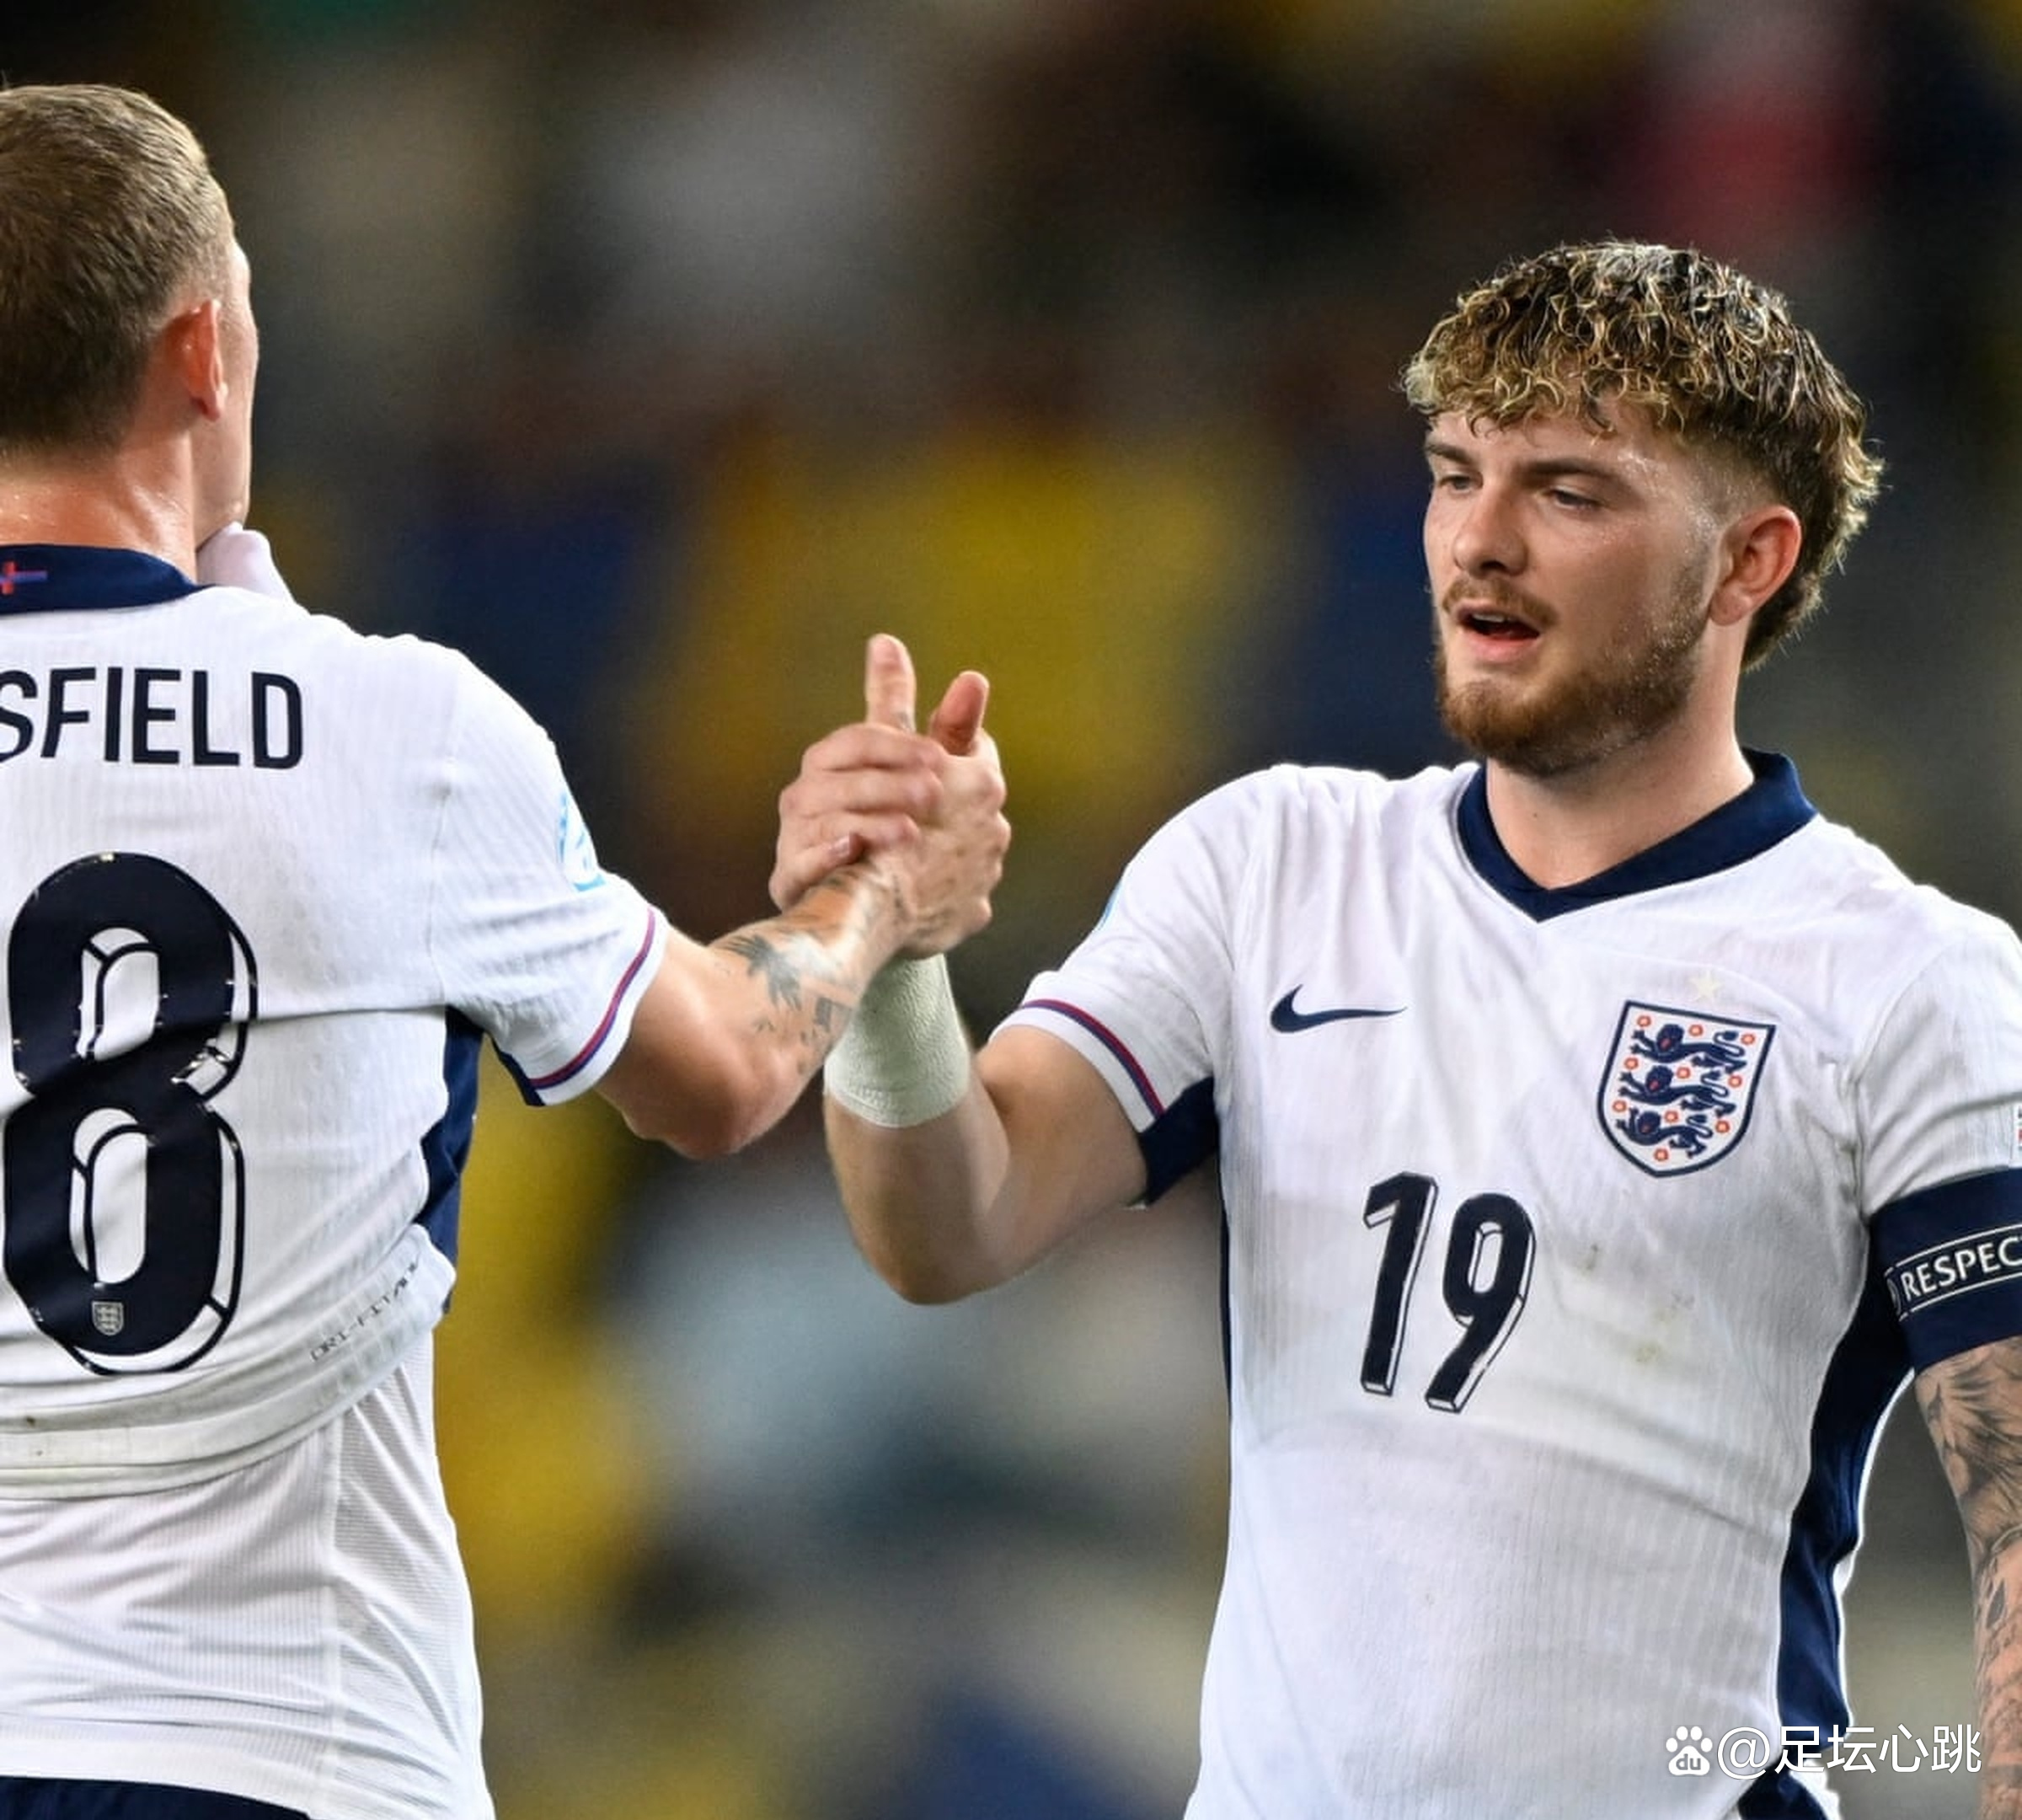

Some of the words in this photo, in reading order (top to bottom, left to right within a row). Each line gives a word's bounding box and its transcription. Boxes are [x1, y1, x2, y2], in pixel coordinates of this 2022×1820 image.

[0, 667, 302, 769] SFIELD
[3, 851, 258, 1377] 8
[1361, 1172, 1536, 1413] 19
[1899, 1235, 2022, 1303] RESPEC
